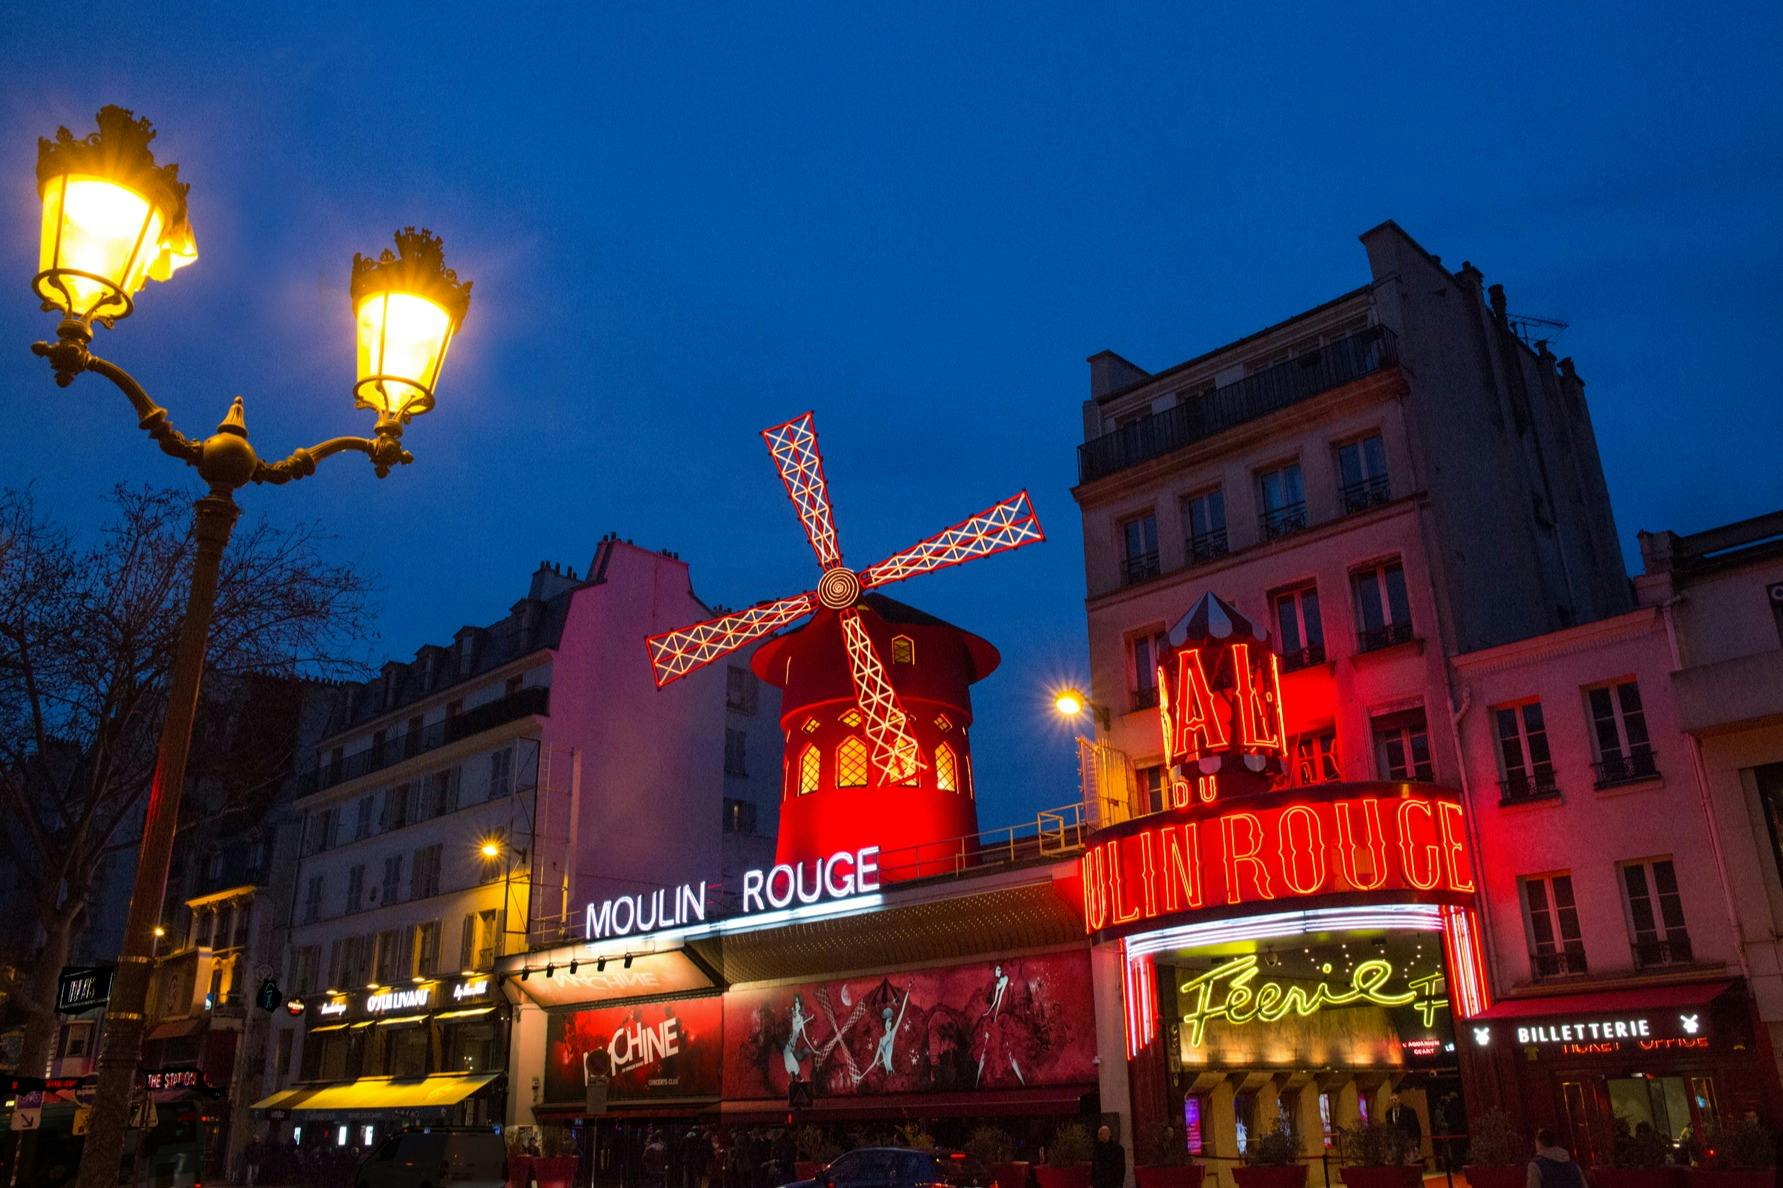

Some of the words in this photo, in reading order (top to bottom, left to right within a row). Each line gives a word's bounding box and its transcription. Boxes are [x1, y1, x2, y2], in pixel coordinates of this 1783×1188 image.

[1173, 776, 1217, 808] DU
[585, 881, 706, 940] MOULIN
[743, 845, 881, 912] ROUGE
[1083, 822, 1202, 934] ULIN
[1220, 799, 1475, 905] ROUGE
[1180, 955, 1417, 1047] Féerie
[1518, 1020, 1650, 1044] BILLETTERIE
